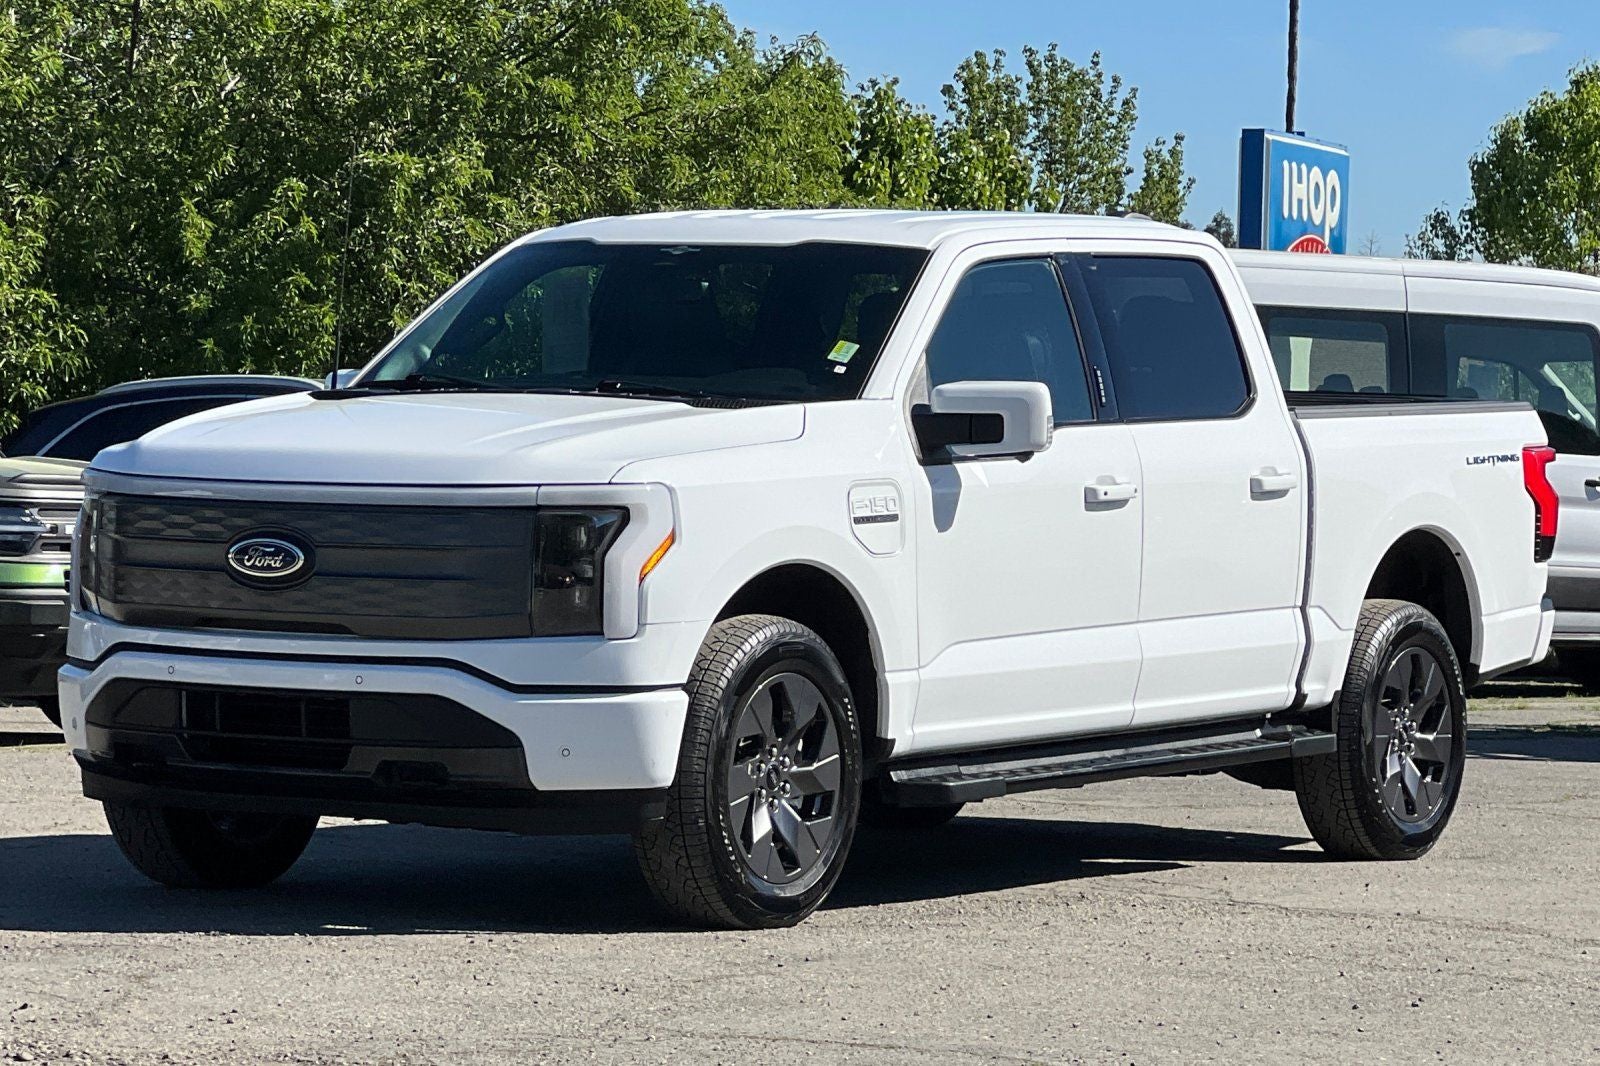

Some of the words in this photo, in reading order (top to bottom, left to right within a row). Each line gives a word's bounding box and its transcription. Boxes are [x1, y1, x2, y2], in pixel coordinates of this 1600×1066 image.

[1465, 453, 1520, 467] LIGHTNING
[851, 496, 898, 515] F-150
[243, 545, 285, 568] Ford
